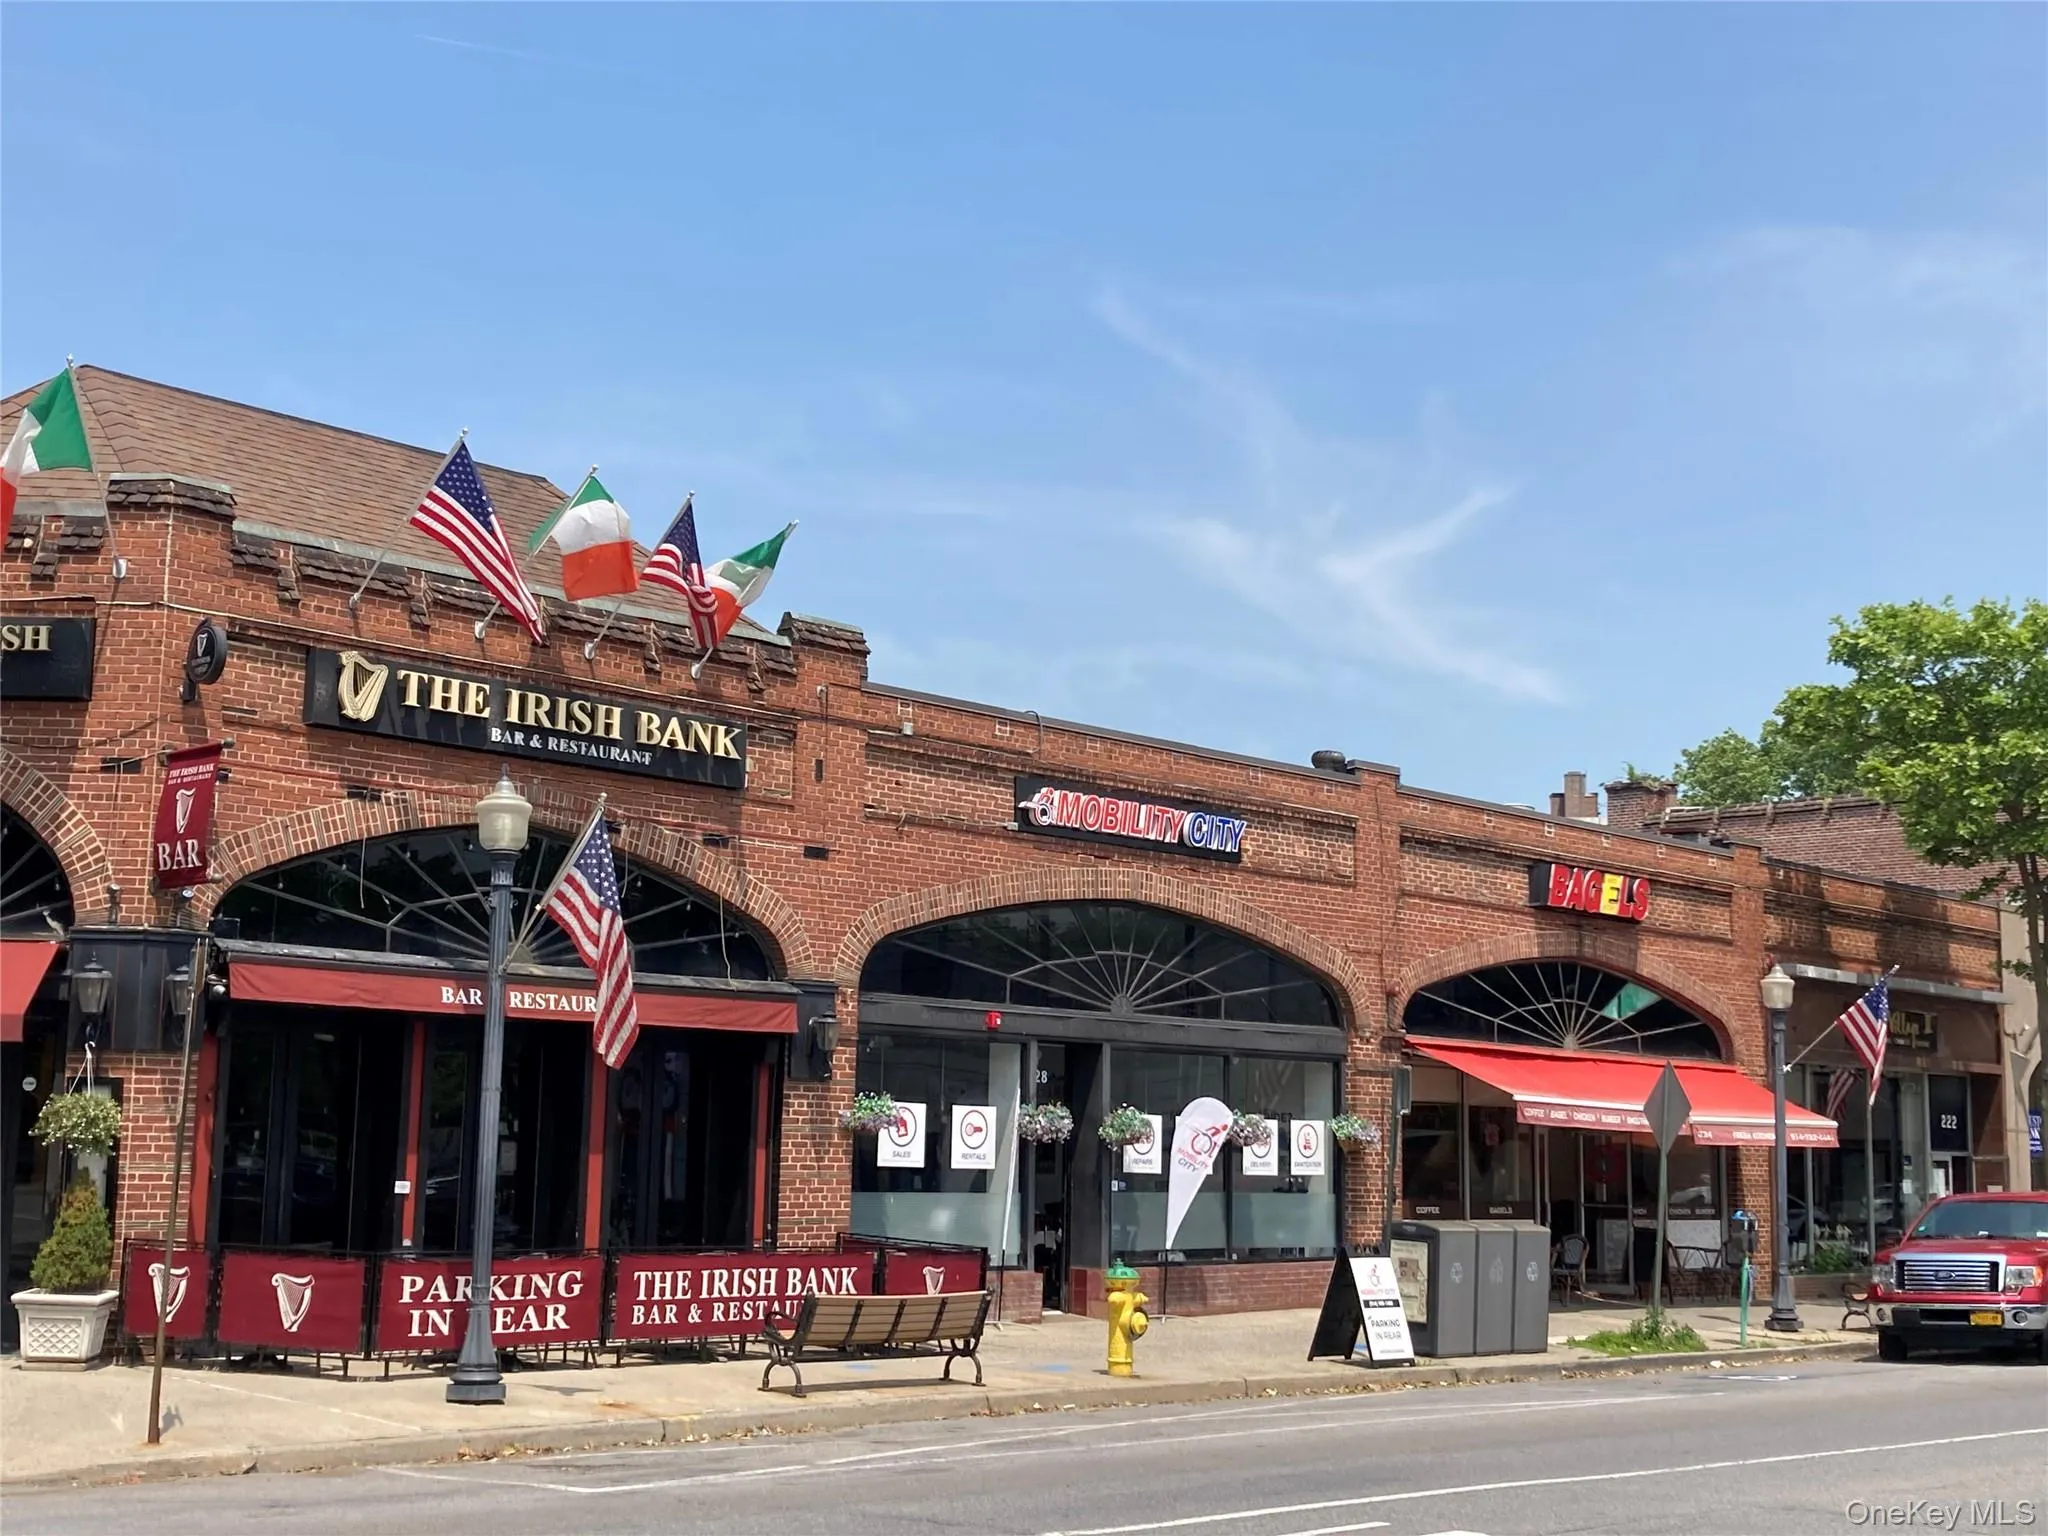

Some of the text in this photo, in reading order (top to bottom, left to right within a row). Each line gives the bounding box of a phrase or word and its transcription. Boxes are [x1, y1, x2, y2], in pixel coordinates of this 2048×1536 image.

[0, 624, 53, 651] SH
[397, 669, 742, 761] THE IRISH BANK
[491, 727, 653, 766] BAR & RESTAURANT
[181, 765, 199, 776] IRISH
[1057, 790, 1248, 852] MOBILITY CITY
[156, 839, 203, 872] BAR
[1548, 864, 1651, 921] BAGELS
[441, 986, 483, 1006] BAR
[1941, 1114, 1957, 1129] 222
[892, 1150, 911, 1159] SALES
[961, 1152, 987, 1160] RENTALS
[1177, 1147, 1209, 1169] MOBILITY
[1178, 1157, 1199, 1173] CITY
[1415, 1206, 1440, 1214] COFFEE
[398, 1270, 584, 1303] PARKING
[633, 1266, 858, 1300] THE IRISH BANK
[407, 1303, 570, 1337] IN EAR
[631, 1299, 804, 1325] BAR & RESTAU
[1371, 1319, 1401, 1328] PARKING
[1375, 1331, 1402, 1340] IN REAR
